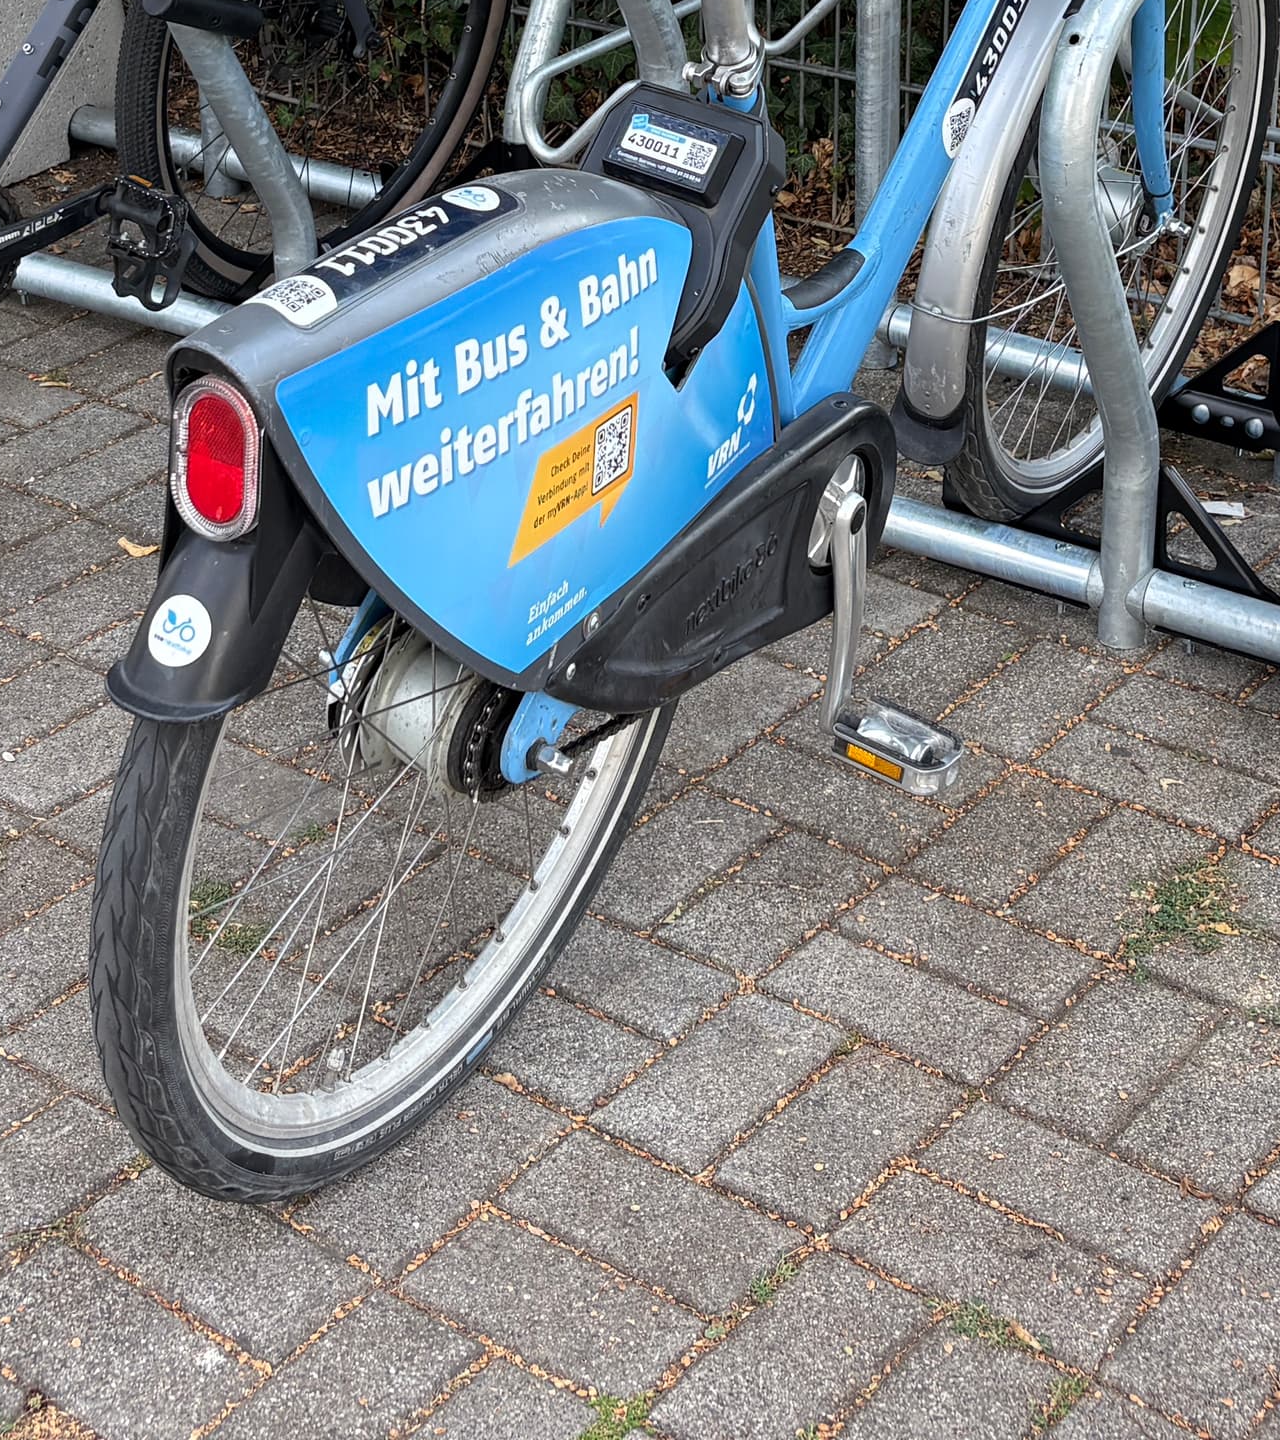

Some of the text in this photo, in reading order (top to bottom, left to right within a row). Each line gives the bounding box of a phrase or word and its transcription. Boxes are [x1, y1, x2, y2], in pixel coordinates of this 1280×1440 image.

[627, 132, 680, 160] 430011
[314, 205, 450, 277] 430011
[366, 246, 659, 438] Mit Bus & Bahn
[366, 324, 640, 520] weiterfahren!
[550, 444, 591, 478] Check Deine
[706, 424, 743, 480] VRN
[533, 481, 589, 529] der myVRN-App!
[537, 462, 590, 506] Verbindung mit
[525, 586, 588, 647] ankommen.
[527, 579, 569, 625] Einfach
